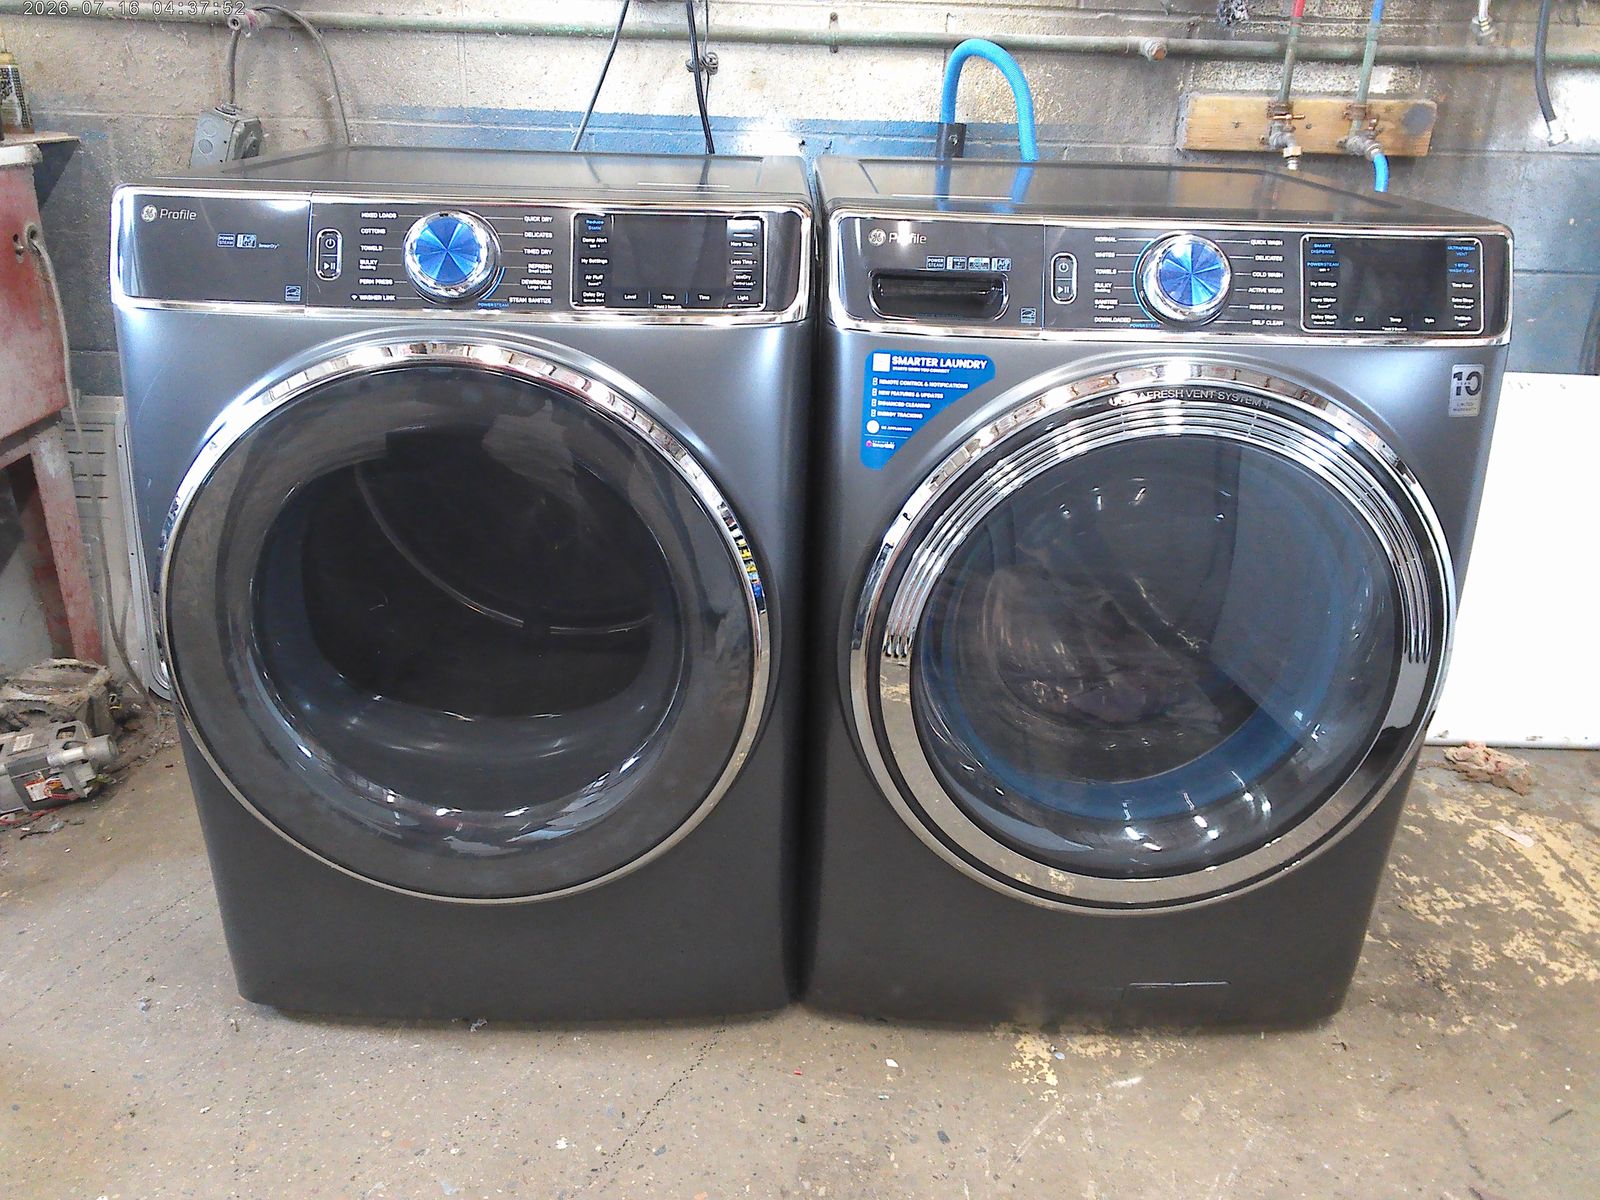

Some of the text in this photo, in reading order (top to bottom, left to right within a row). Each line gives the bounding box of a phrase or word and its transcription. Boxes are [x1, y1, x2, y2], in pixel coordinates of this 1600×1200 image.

[160, 208, 197, 221] Profile
[889, 231, 927, 245] Pfile
[892, 356, 988, 369] SMARTER LAUNDRY
[1453, 371, 1482, 396] 10
[1186, 389, 1215, 399] VENT
